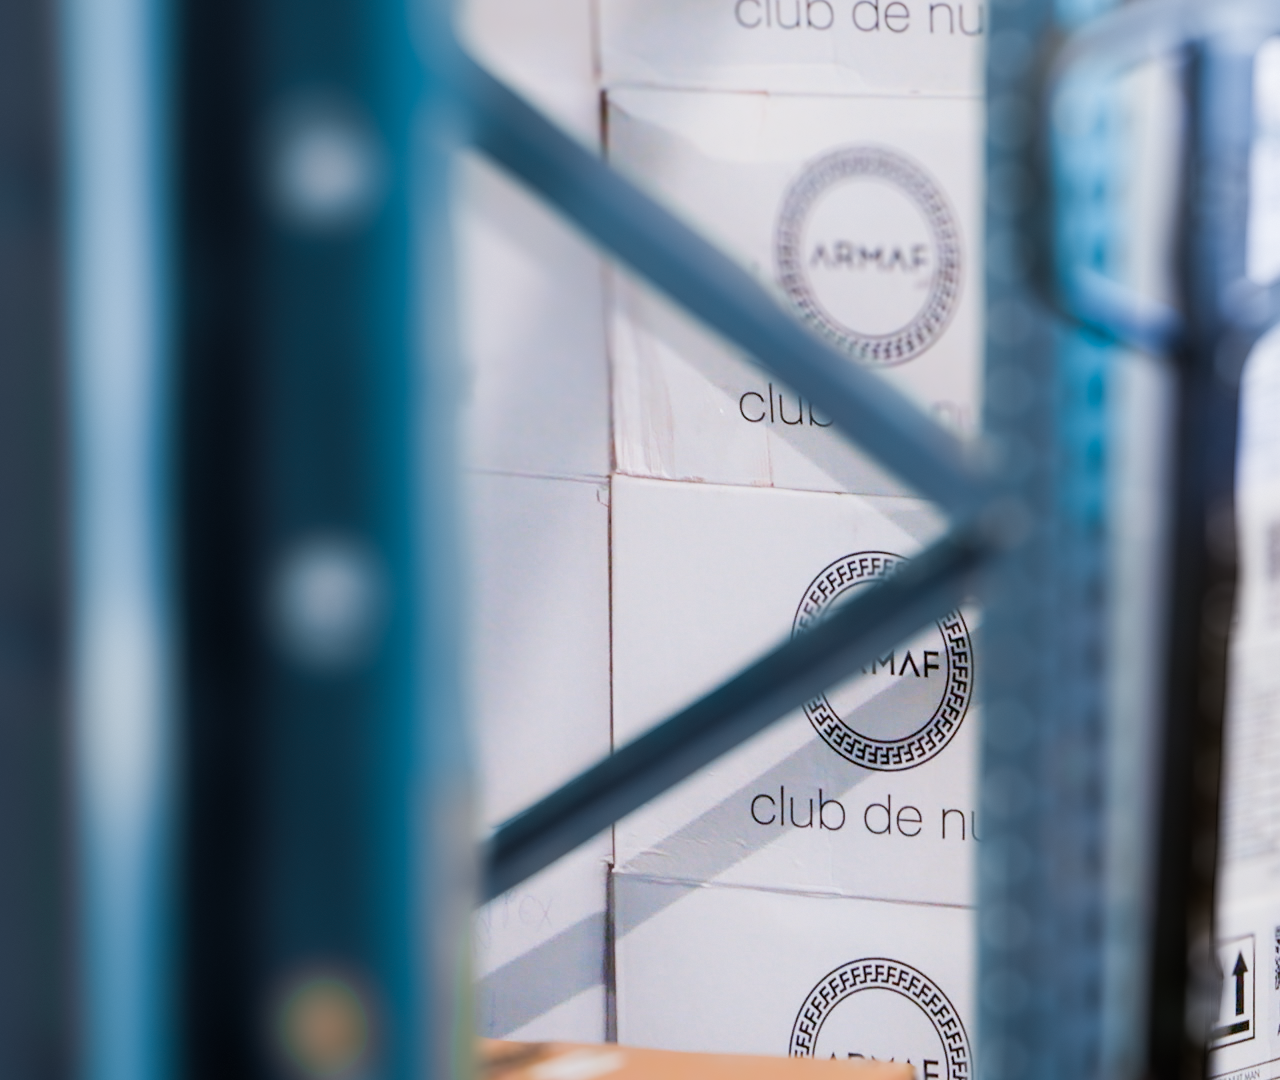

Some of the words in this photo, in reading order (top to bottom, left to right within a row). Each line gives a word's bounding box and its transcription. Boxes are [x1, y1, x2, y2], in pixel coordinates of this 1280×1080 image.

[929, 1, 984, 37] nu
[809, 241, 929, 274] ARMAF
[751, 785, 846, 831] club
[864, 794, 922, 837] de
